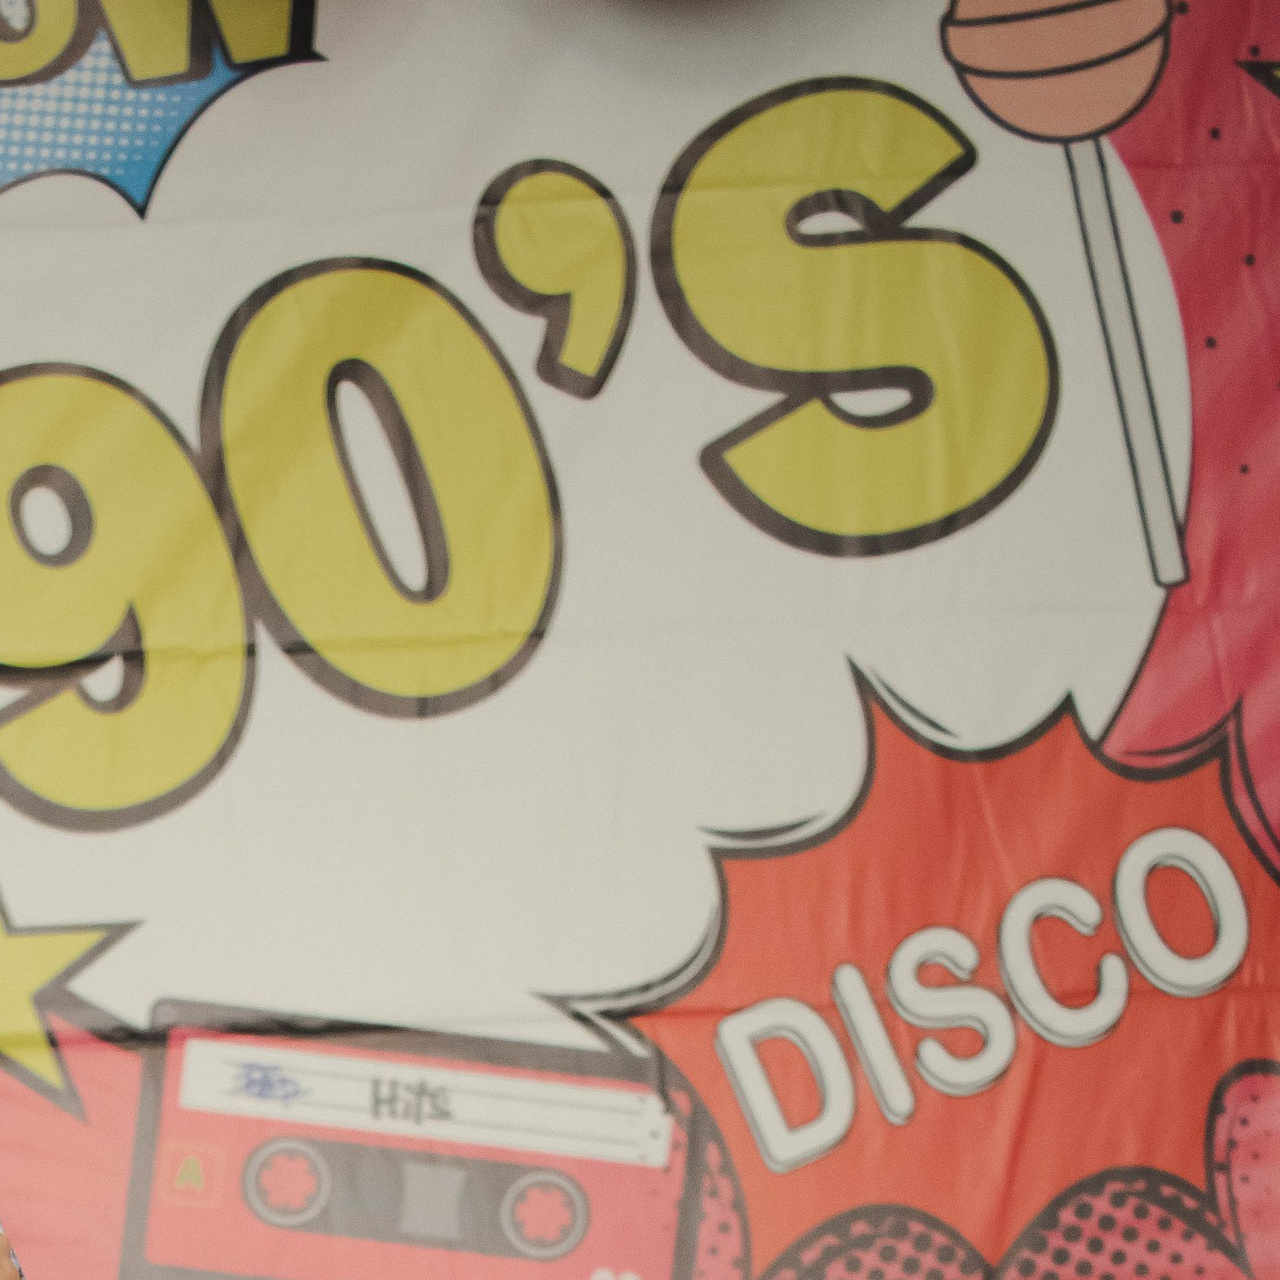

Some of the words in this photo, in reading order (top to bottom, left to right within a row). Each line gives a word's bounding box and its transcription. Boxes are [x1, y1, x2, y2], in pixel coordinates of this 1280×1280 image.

[715, 827, 1249, 1174] DISCO
[369, 1077, 452, 1126] Hits
[176, 1156, 205, 1191] A
